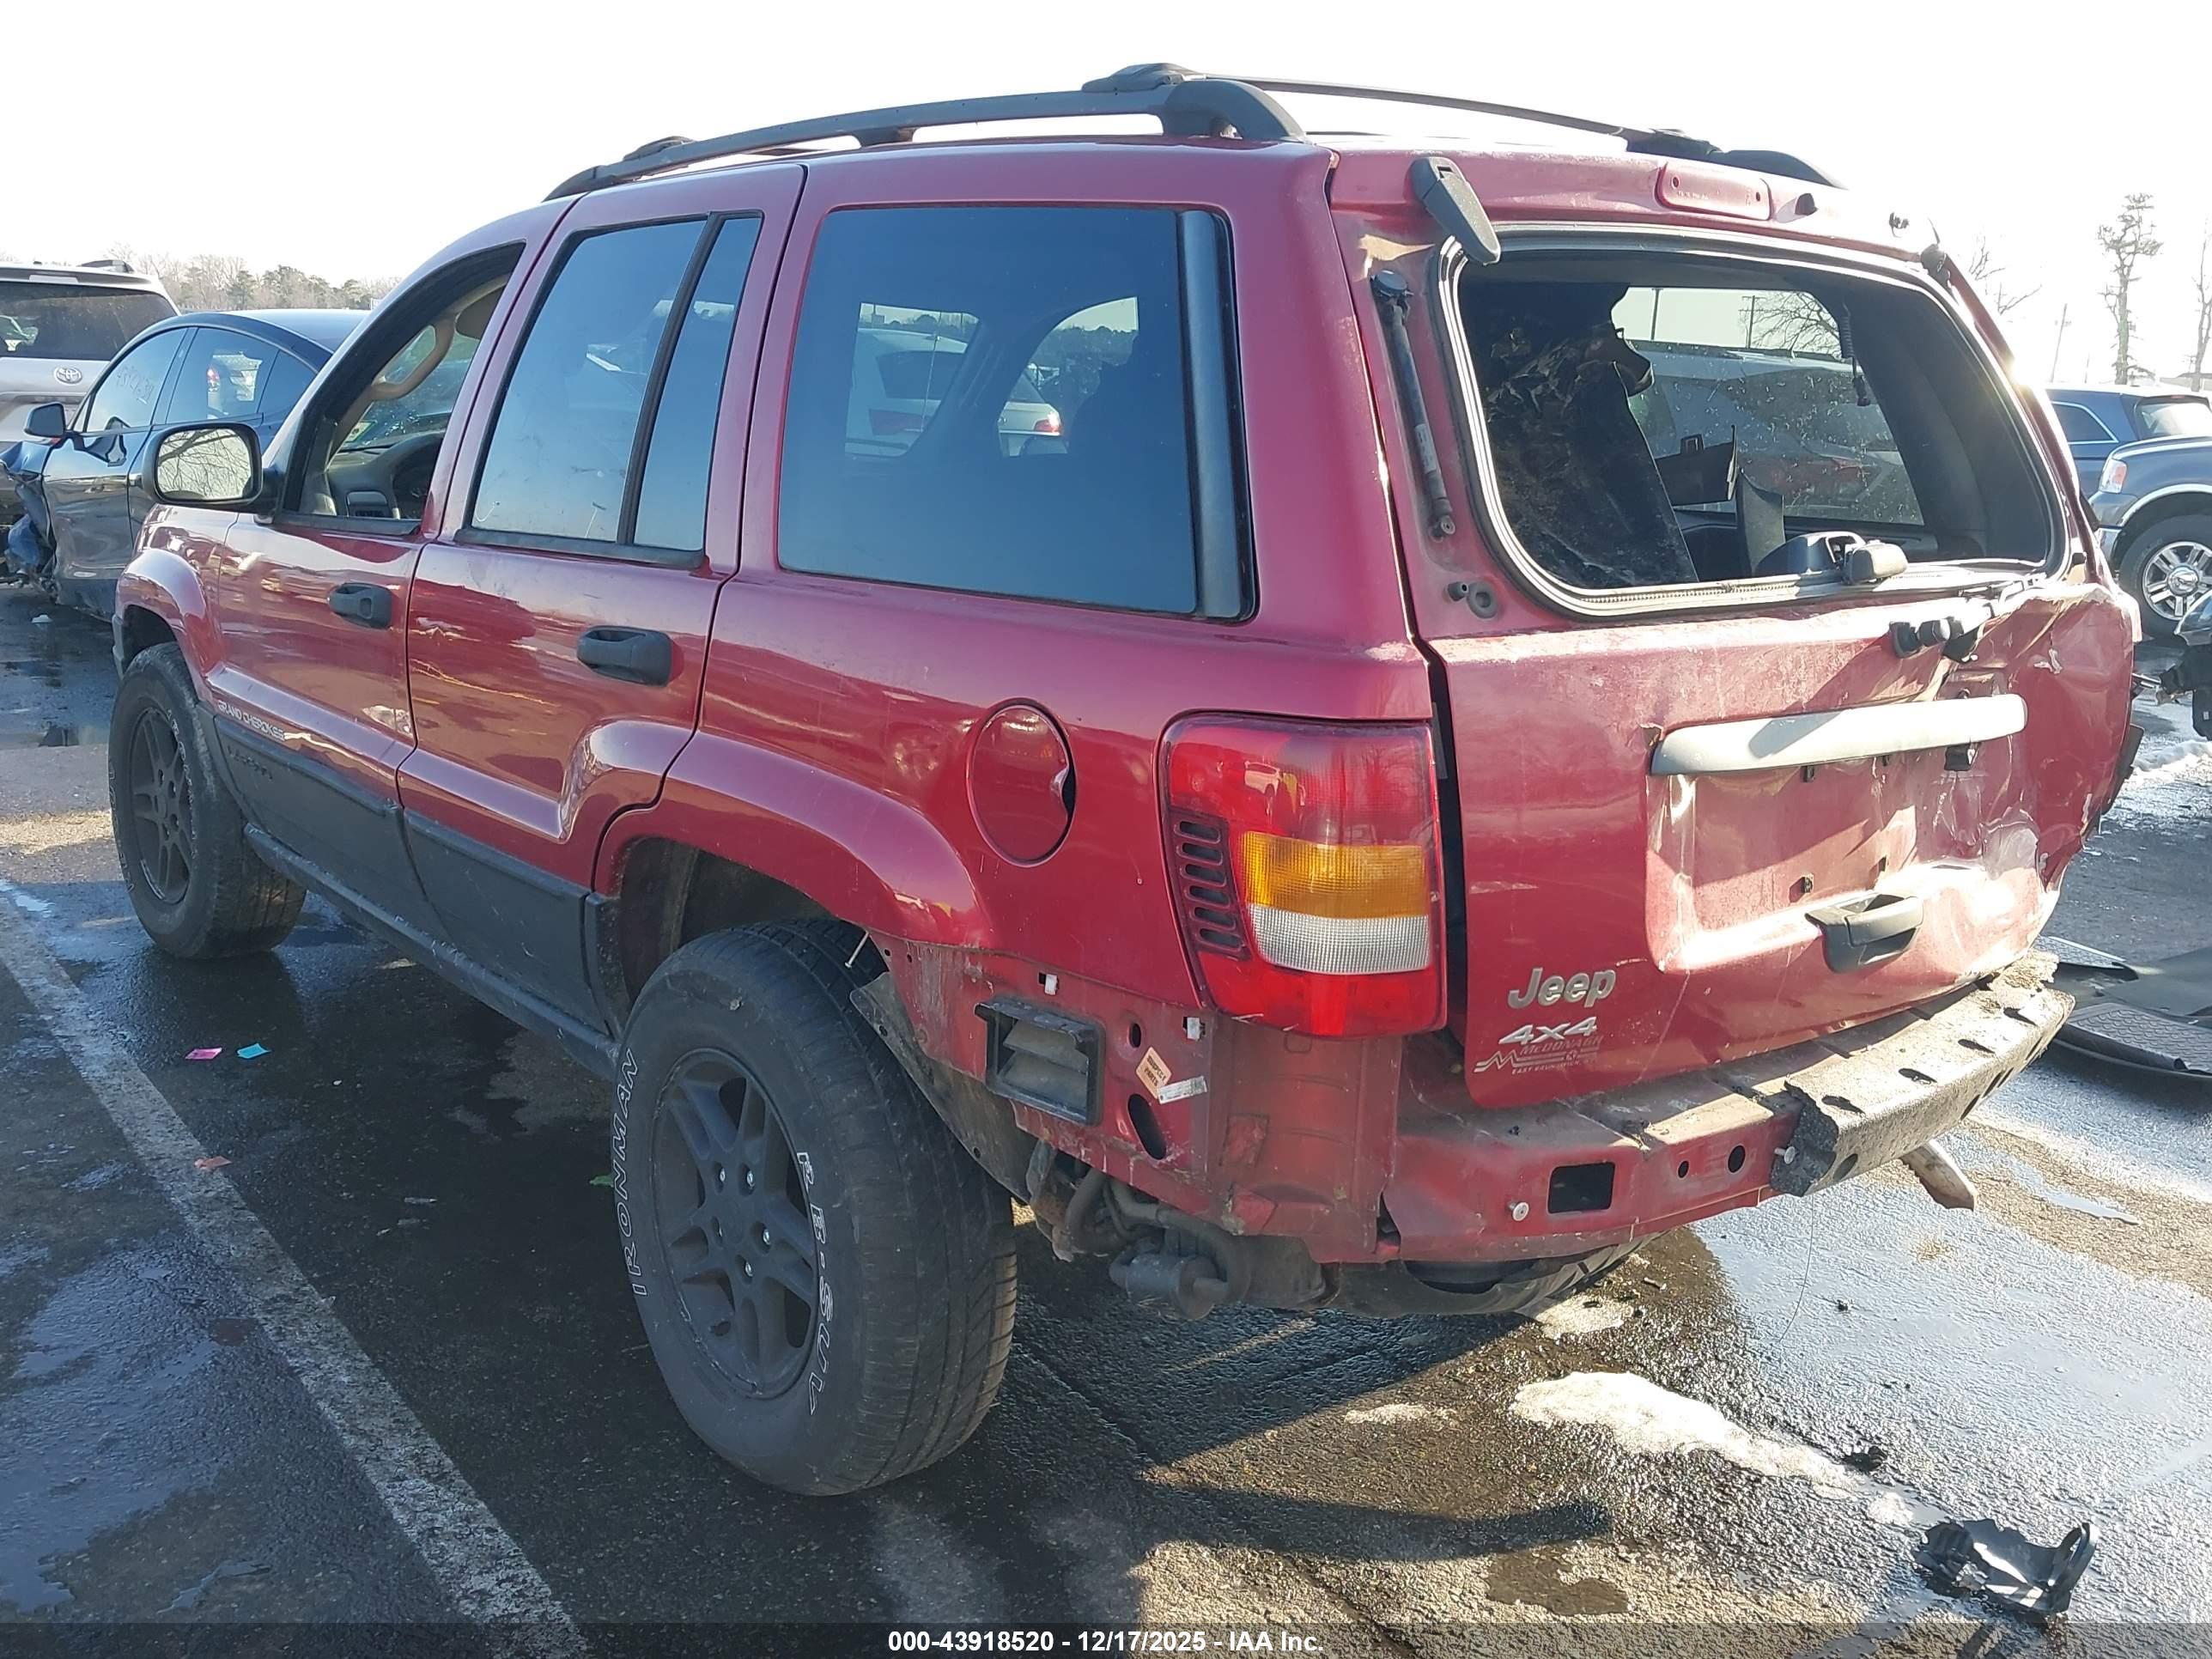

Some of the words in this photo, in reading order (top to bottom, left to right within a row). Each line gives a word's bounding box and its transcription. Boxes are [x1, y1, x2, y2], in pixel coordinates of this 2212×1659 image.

[1507, 966, 1616, 1009] Jeep
[1498, 1016, 1597, 1045] 4x4
[612, 1048, 647, 1297] IRONMAN
